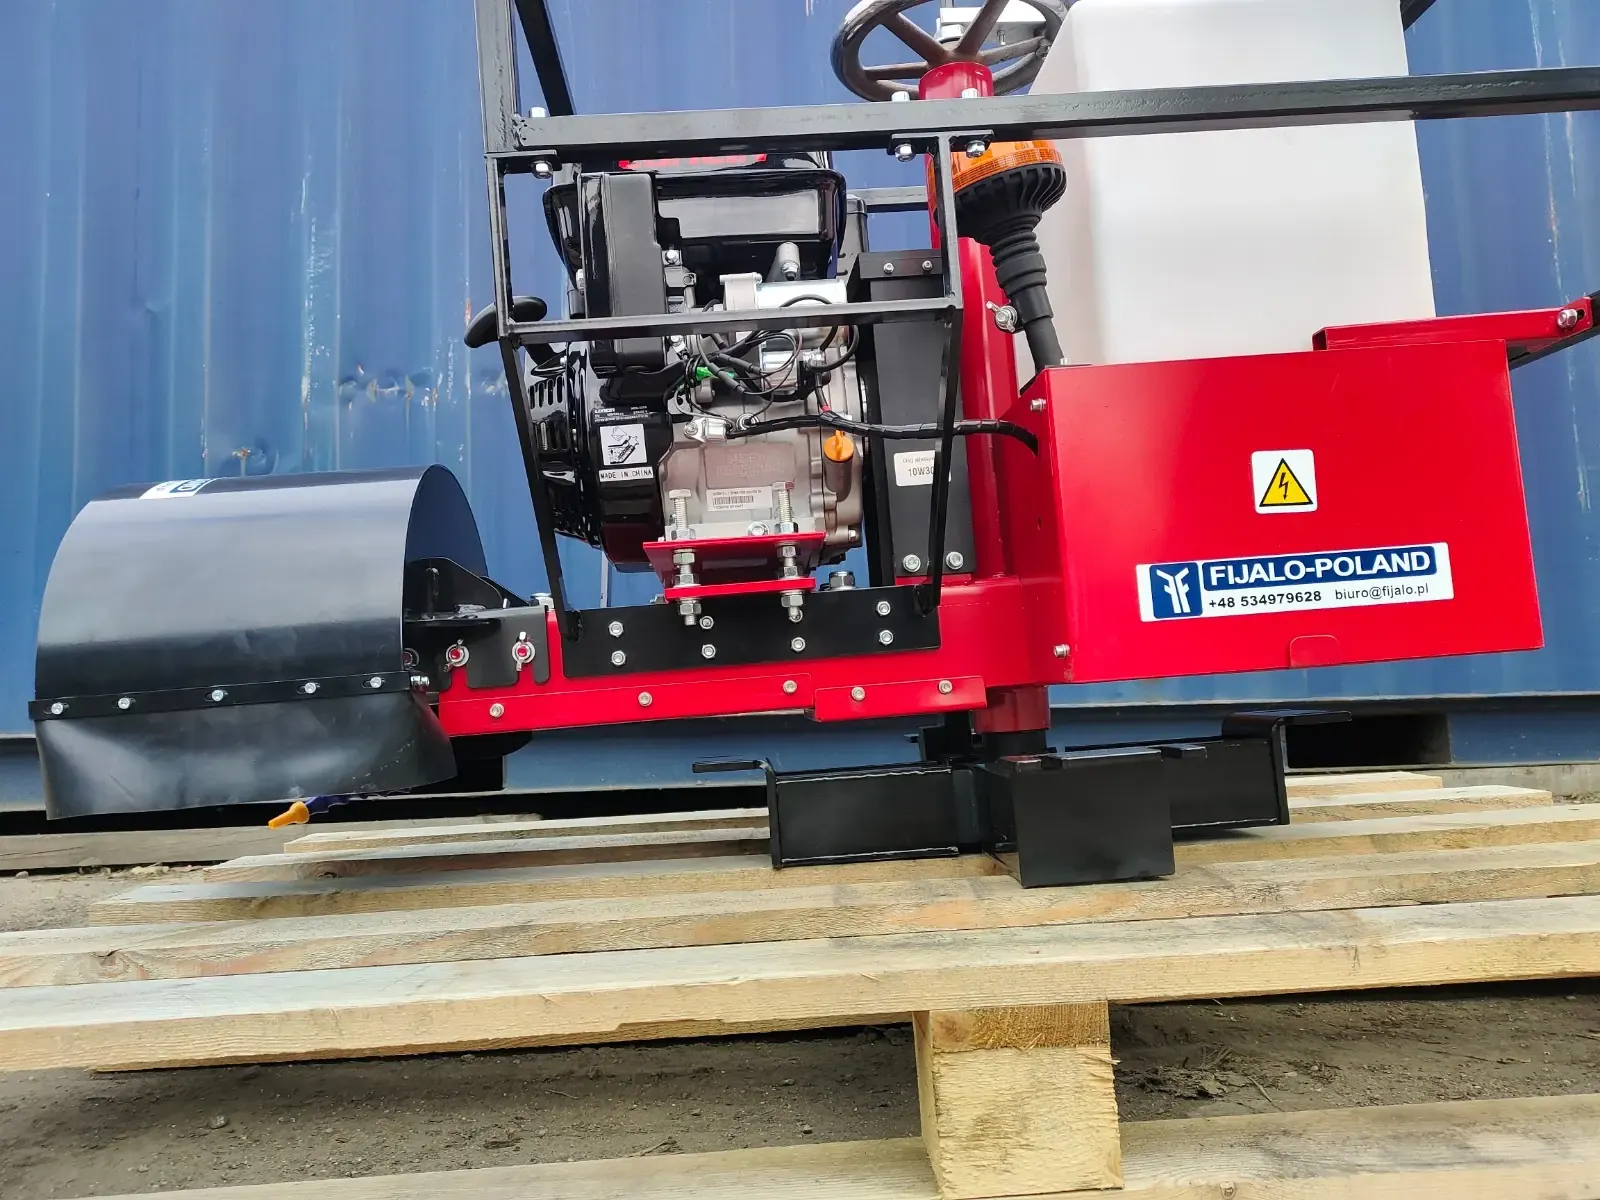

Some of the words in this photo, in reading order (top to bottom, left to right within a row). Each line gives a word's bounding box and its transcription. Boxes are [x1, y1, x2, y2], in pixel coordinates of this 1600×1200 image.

[600, 471, 616, 479] MADE
[621, 470, 629, 478] IN
[631, 469, 652, 477] CHINA
[1209, 551, 1431, 586] FIJALO-POLAND
[1208, 596, 1235, 609] +48
[1240, 590, 1322, 608] 534979628
[1335, 583, 1429, 601] biuro@fijalo.pl
